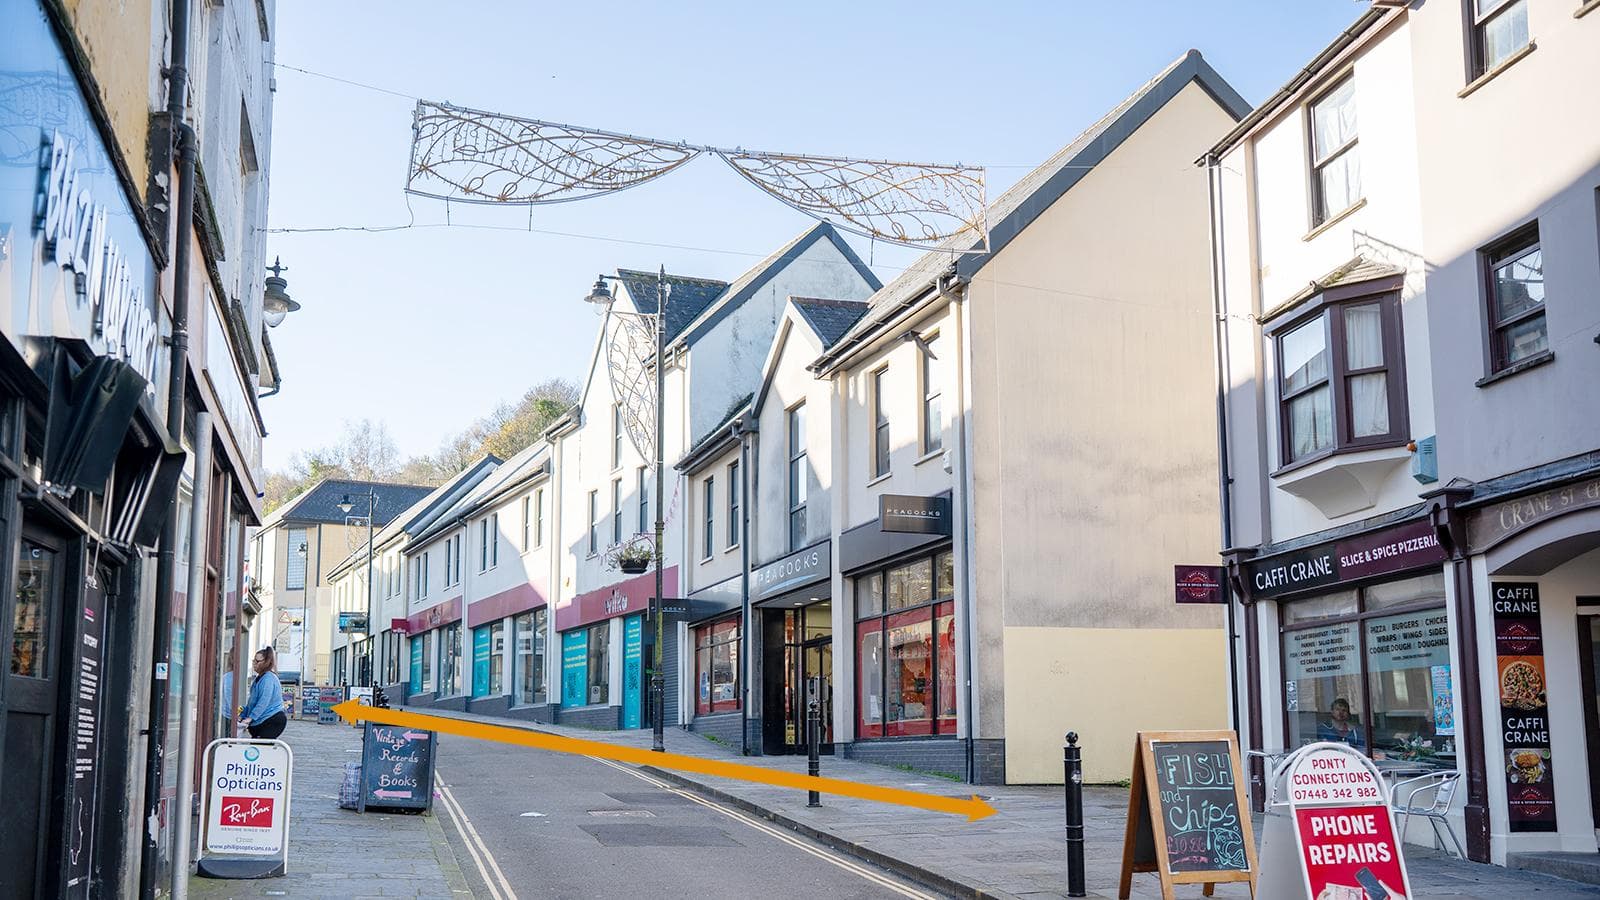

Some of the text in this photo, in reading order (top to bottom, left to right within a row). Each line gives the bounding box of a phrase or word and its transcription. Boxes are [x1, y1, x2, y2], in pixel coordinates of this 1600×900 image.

[886, 508, 941, 517] PEACOCKS
[1500, 494, 1553, 530] CRANE
[1560, 488, 1574, 506] ST
[1340, 534, 1440, 568] SLICE & SPICE PIZZERIA
[758, 552, 819, 588] PEACOCKS
[1255, 555, 1333, 591] CAFFI CRANE
[1497, 588, 1533, 599] CAFFI
[1495, 601, 1538, 613] CRANE
[1370, 625, 1386, 634] PIZZA
[1391, 620, 1419, 632] BURGERS
[1376, 628, 1447, 643] WRAPS WINGS SIDES
[1369, 645, 1390, 655] COOKIE
[1391, 642, 1412, 652] DOUGH
[1507, 718, 1544, 729] CAFFI
[373, 729, 405, 751] Vintage
[1505, 731, 1549, 743] CRANE
[379, 749, 419, 763] Records
[1312, 758, 1346, 769] PONTY
[226, 763, 276, 779] Phillips
[1162, 752, 1234, 785] FISH
[217, 777, 282, 792] Opticians
[378, 774, 418, 788] Books
[1293, 772, 1371, 785] CONNECTIONS
[1160, 785, 1184, 803] and
[1295, 787, 1377, 800] 07448 342 982
[223, 799, 271, 823] Ray-Ban
[1310, 814, 1378, 837] PHONE
[1308, 842, 1391, 866] REPAIRS
